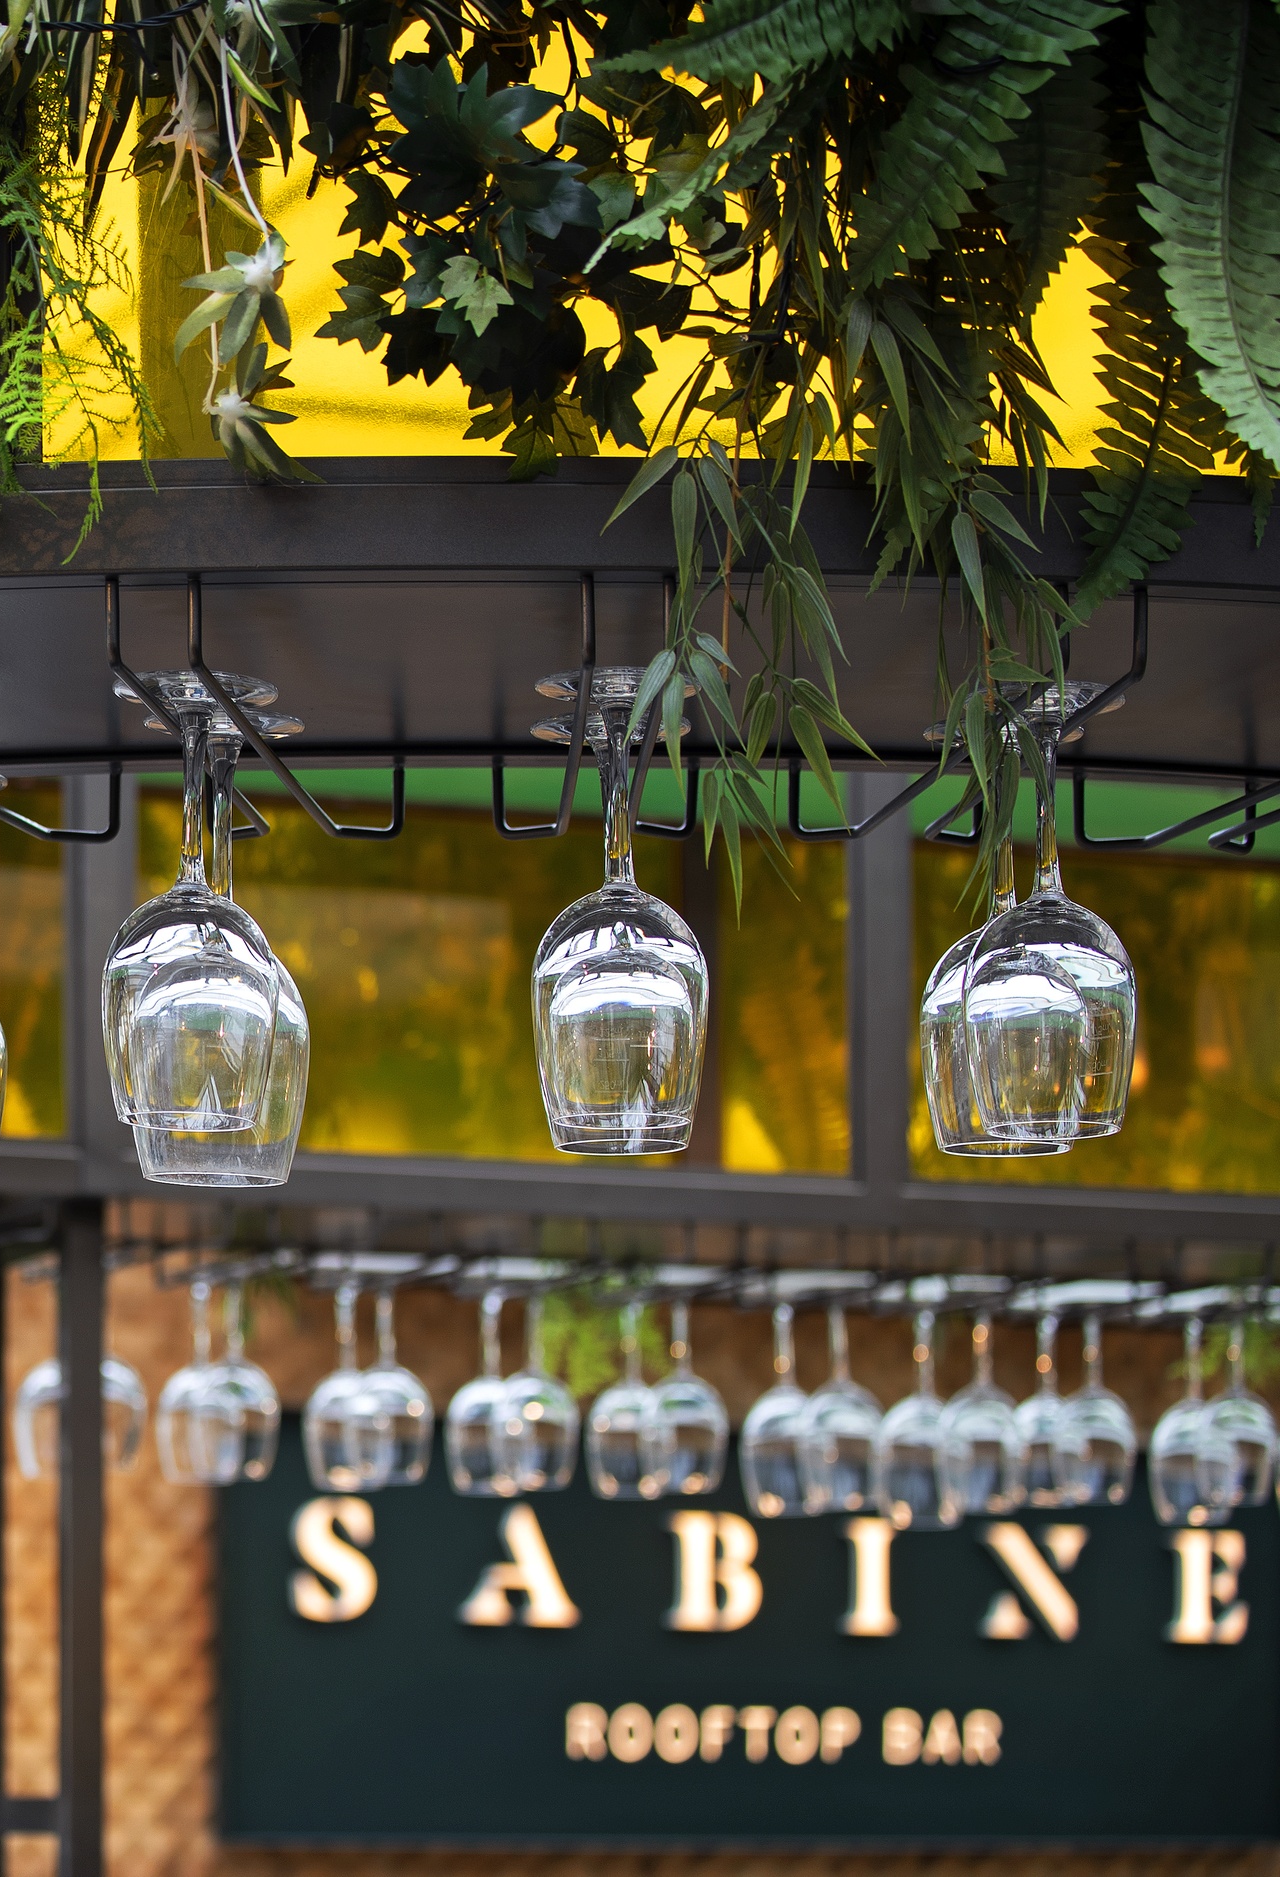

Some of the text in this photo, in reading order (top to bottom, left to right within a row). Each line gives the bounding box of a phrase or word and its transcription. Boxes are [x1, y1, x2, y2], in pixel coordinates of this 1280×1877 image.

[289, 1496, 1250, 1643] SABINE
[565, 1702, 1003, 1766] ROOFTOP BAR
